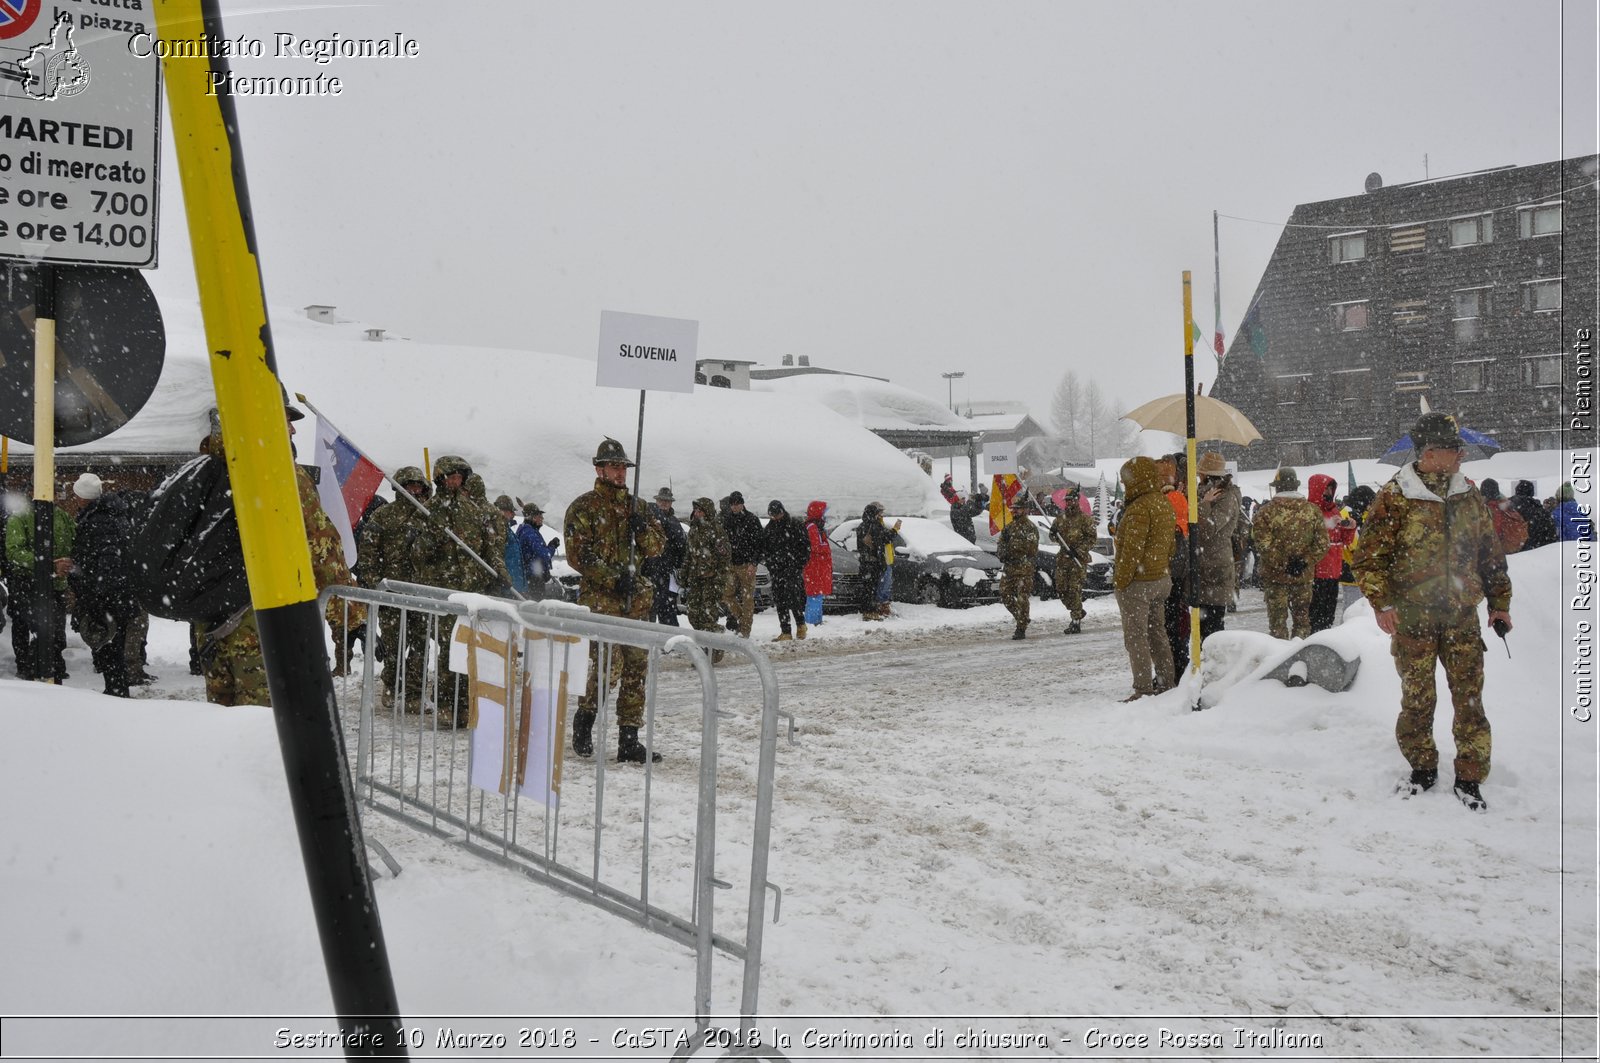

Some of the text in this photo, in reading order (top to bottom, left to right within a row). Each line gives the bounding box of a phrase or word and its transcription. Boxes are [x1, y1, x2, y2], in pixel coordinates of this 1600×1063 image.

[80, 12, 146, 34] piazza
[19, 151, 42, 175] di
[47, 157, 147, 185] mercato
[17, 189, 68, 210] ore
[90, 190, 149, 217] 7,00
[16, 221, 67, 242] ore
[73, 221, 147, 248] 14,00
[619, 343, 677, 362] SLOVENIA
